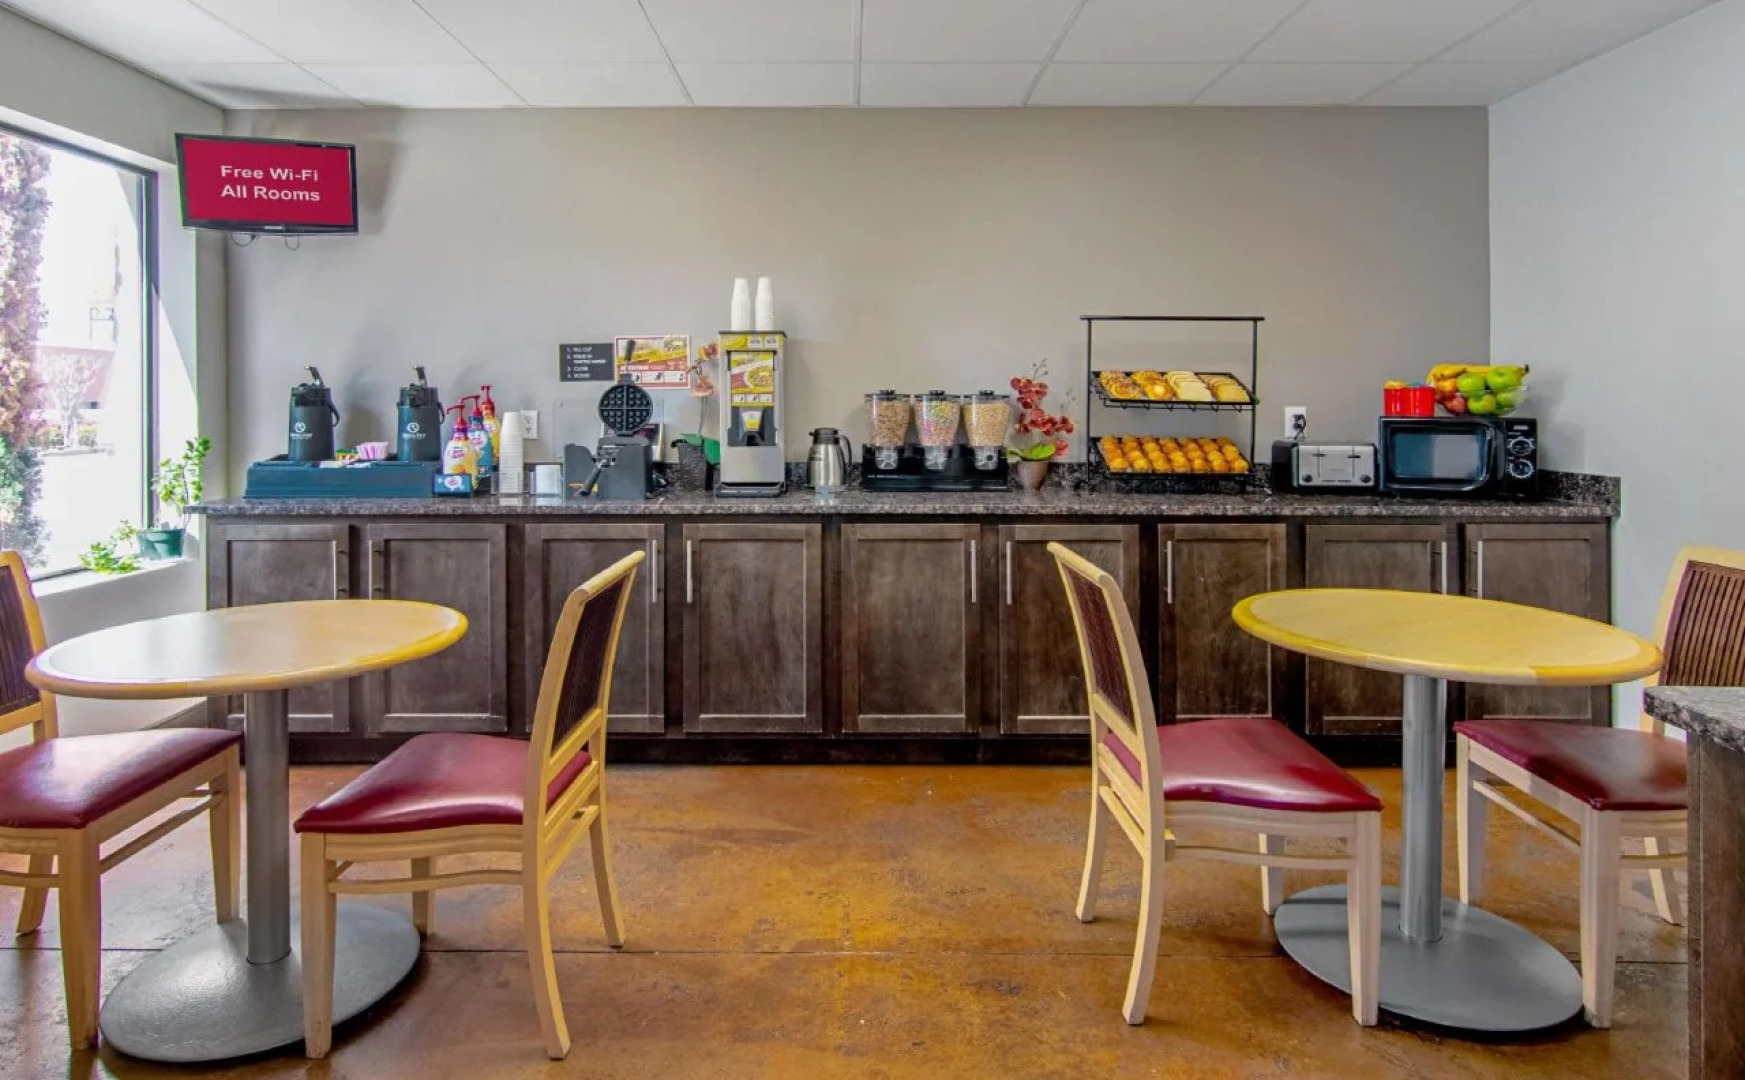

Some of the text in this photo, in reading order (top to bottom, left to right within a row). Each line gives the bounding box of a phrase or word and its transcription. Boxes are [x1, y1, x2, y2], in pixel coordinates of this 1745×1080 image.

[220, 165, 319, 181] Free Wi-Fi
[220, 184, 320, 201] All Rooms
